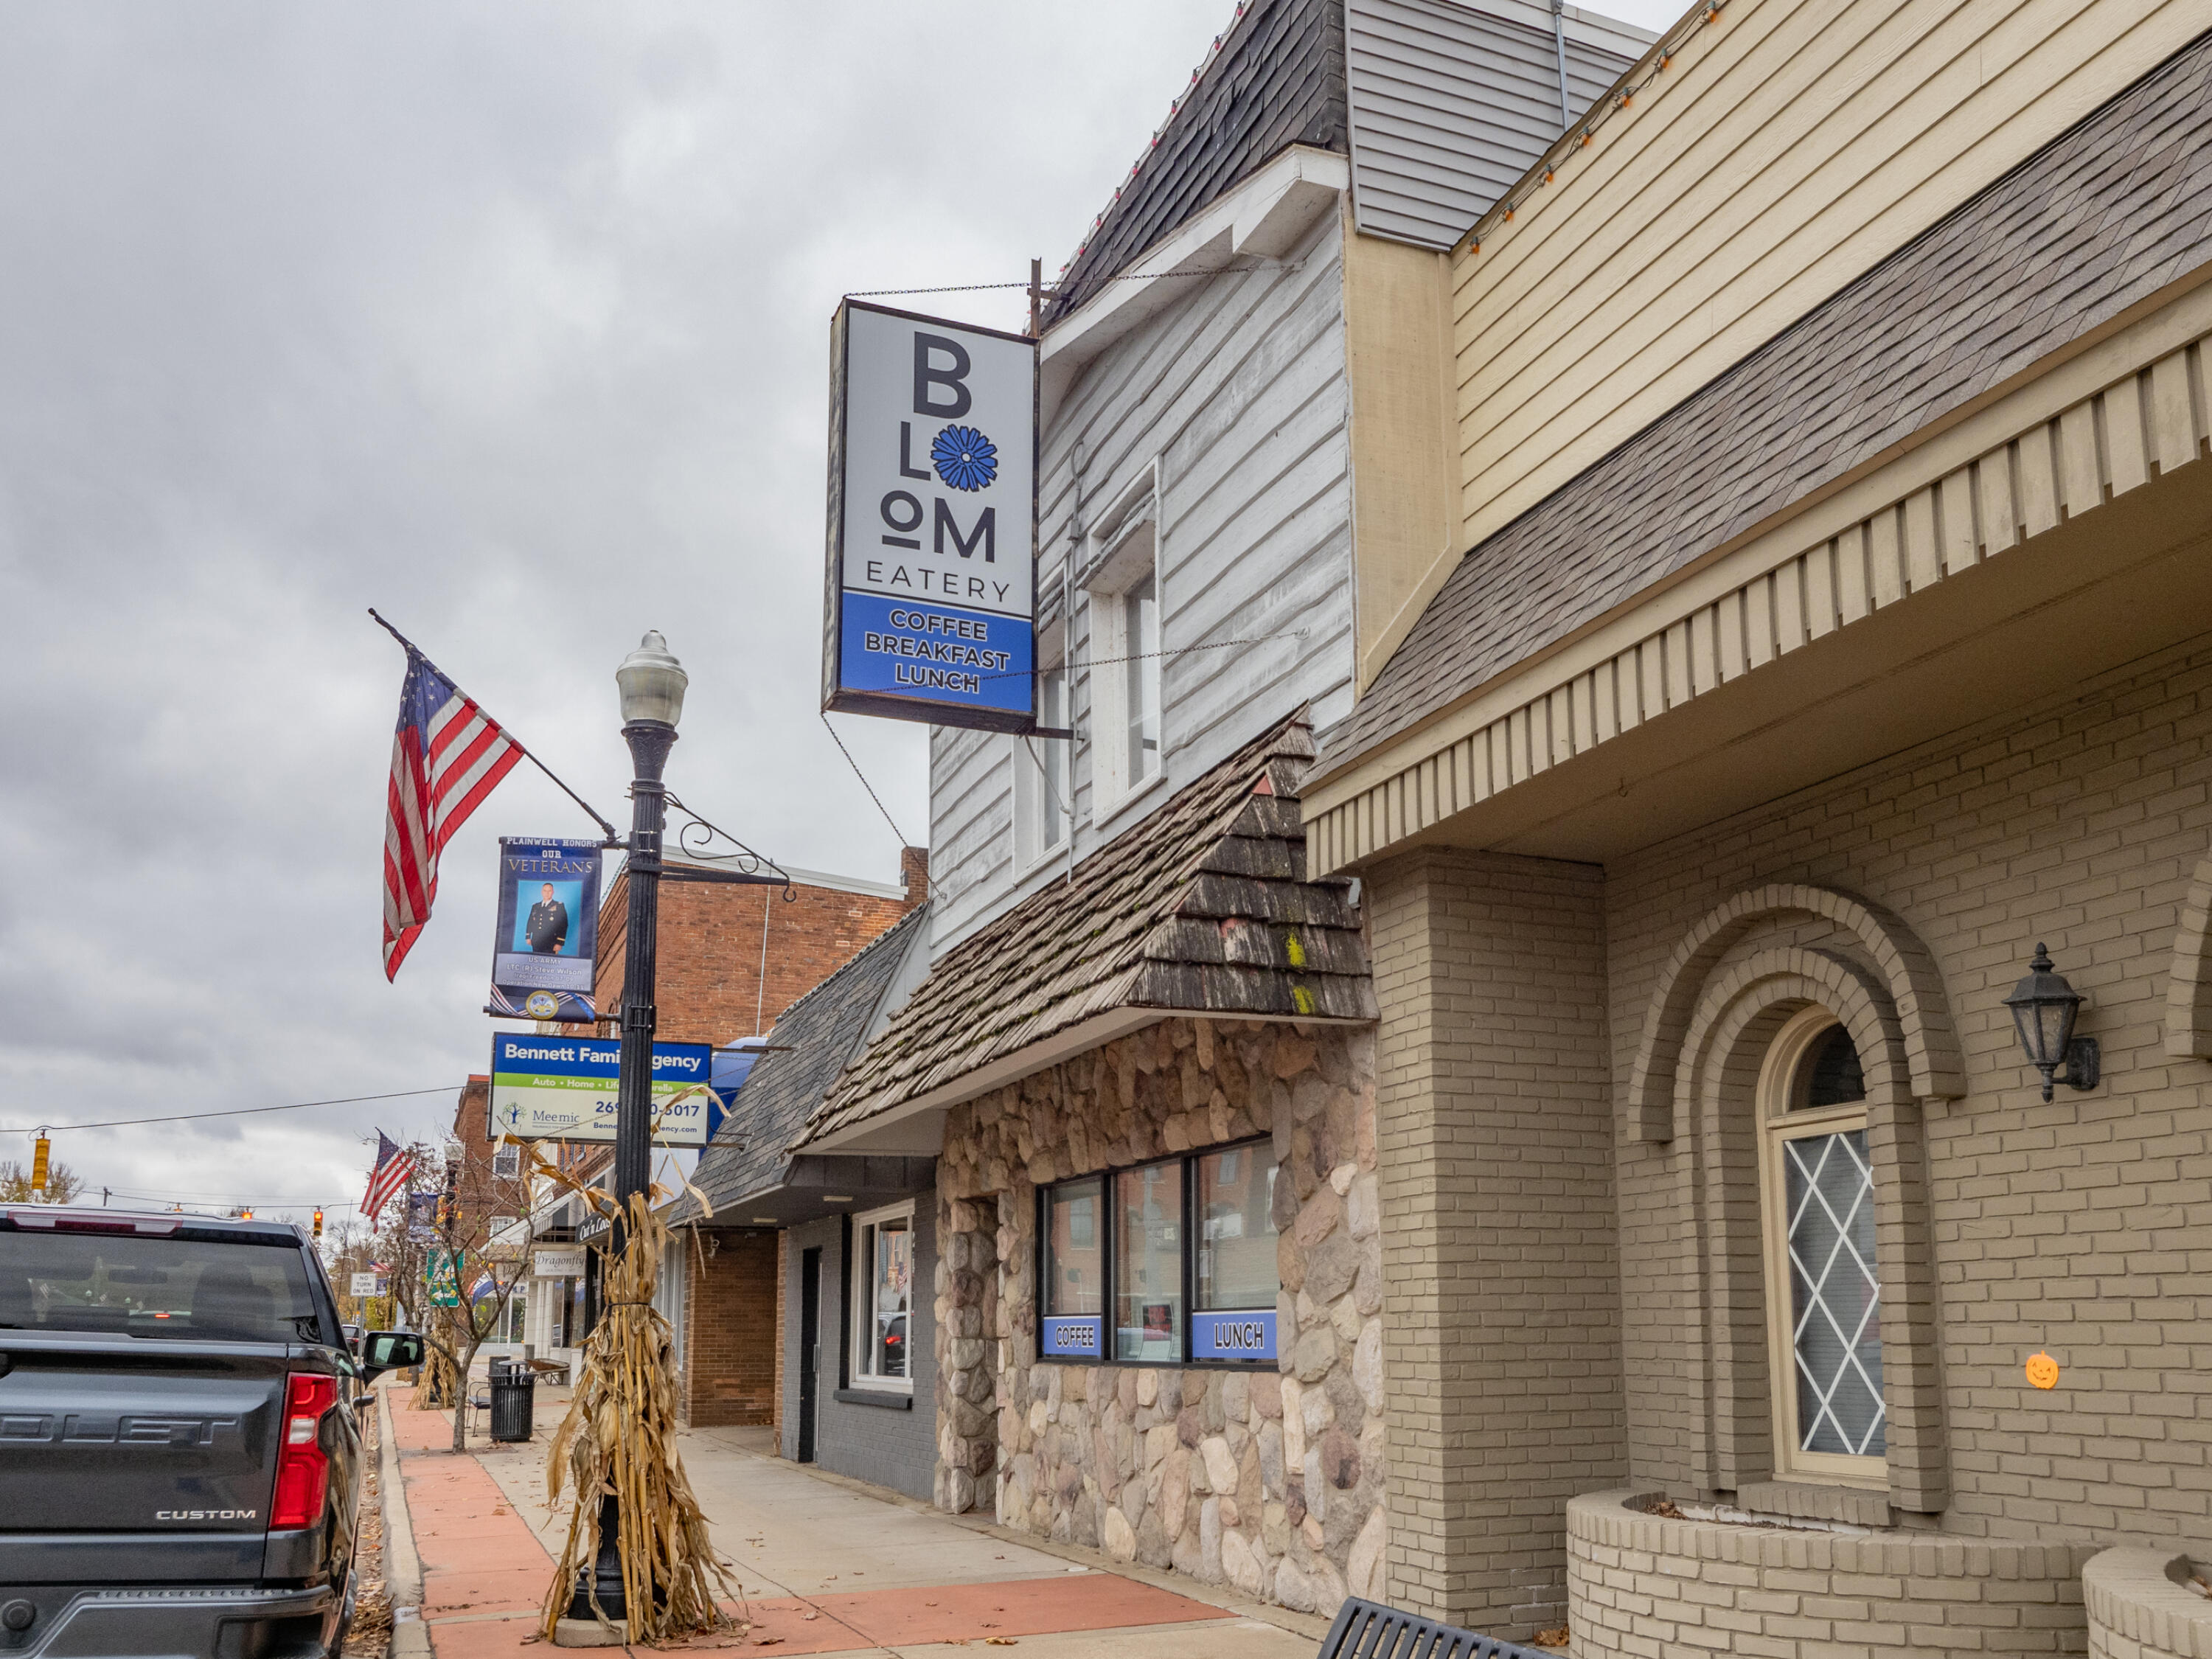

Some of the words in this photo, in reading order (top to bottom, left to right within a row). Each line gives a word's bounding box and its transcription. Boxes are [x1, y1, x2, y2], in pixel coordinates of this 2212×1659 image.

[867, 560, 1009, 602] EATERY
[889, 609, 987, 641] COFFEE
[865, 631, 1010, 671] BREAKFAST
[895, 664, 979, 694] LUNCH
[507, 837, 557, 846] PLAINWELL
[563, 839, 597, 848] HONORS
[542, 849, 562, 859] OUR
[508, 858, 593, 874] VETERANS
[557, 967, 582, 975] Wilson
[505, 1043, 575, 1061] Bennett
[580, 1046, 620, 1064] Fami
[651, 1055, 701, 1072] gency
[532, 1077, 556, 1088] Auto
[567, 1079, 594, 1089] Home
[532, 1110, 580, 1123] Meemic
[537, 1254, 585, 1268] Dragonfly
[1056, 1325, 1094, 1349] COFFEE
[1214, 1321, 1265, 1350] LUNCH
[156, 1509, 257, 1520] CUSTOM
